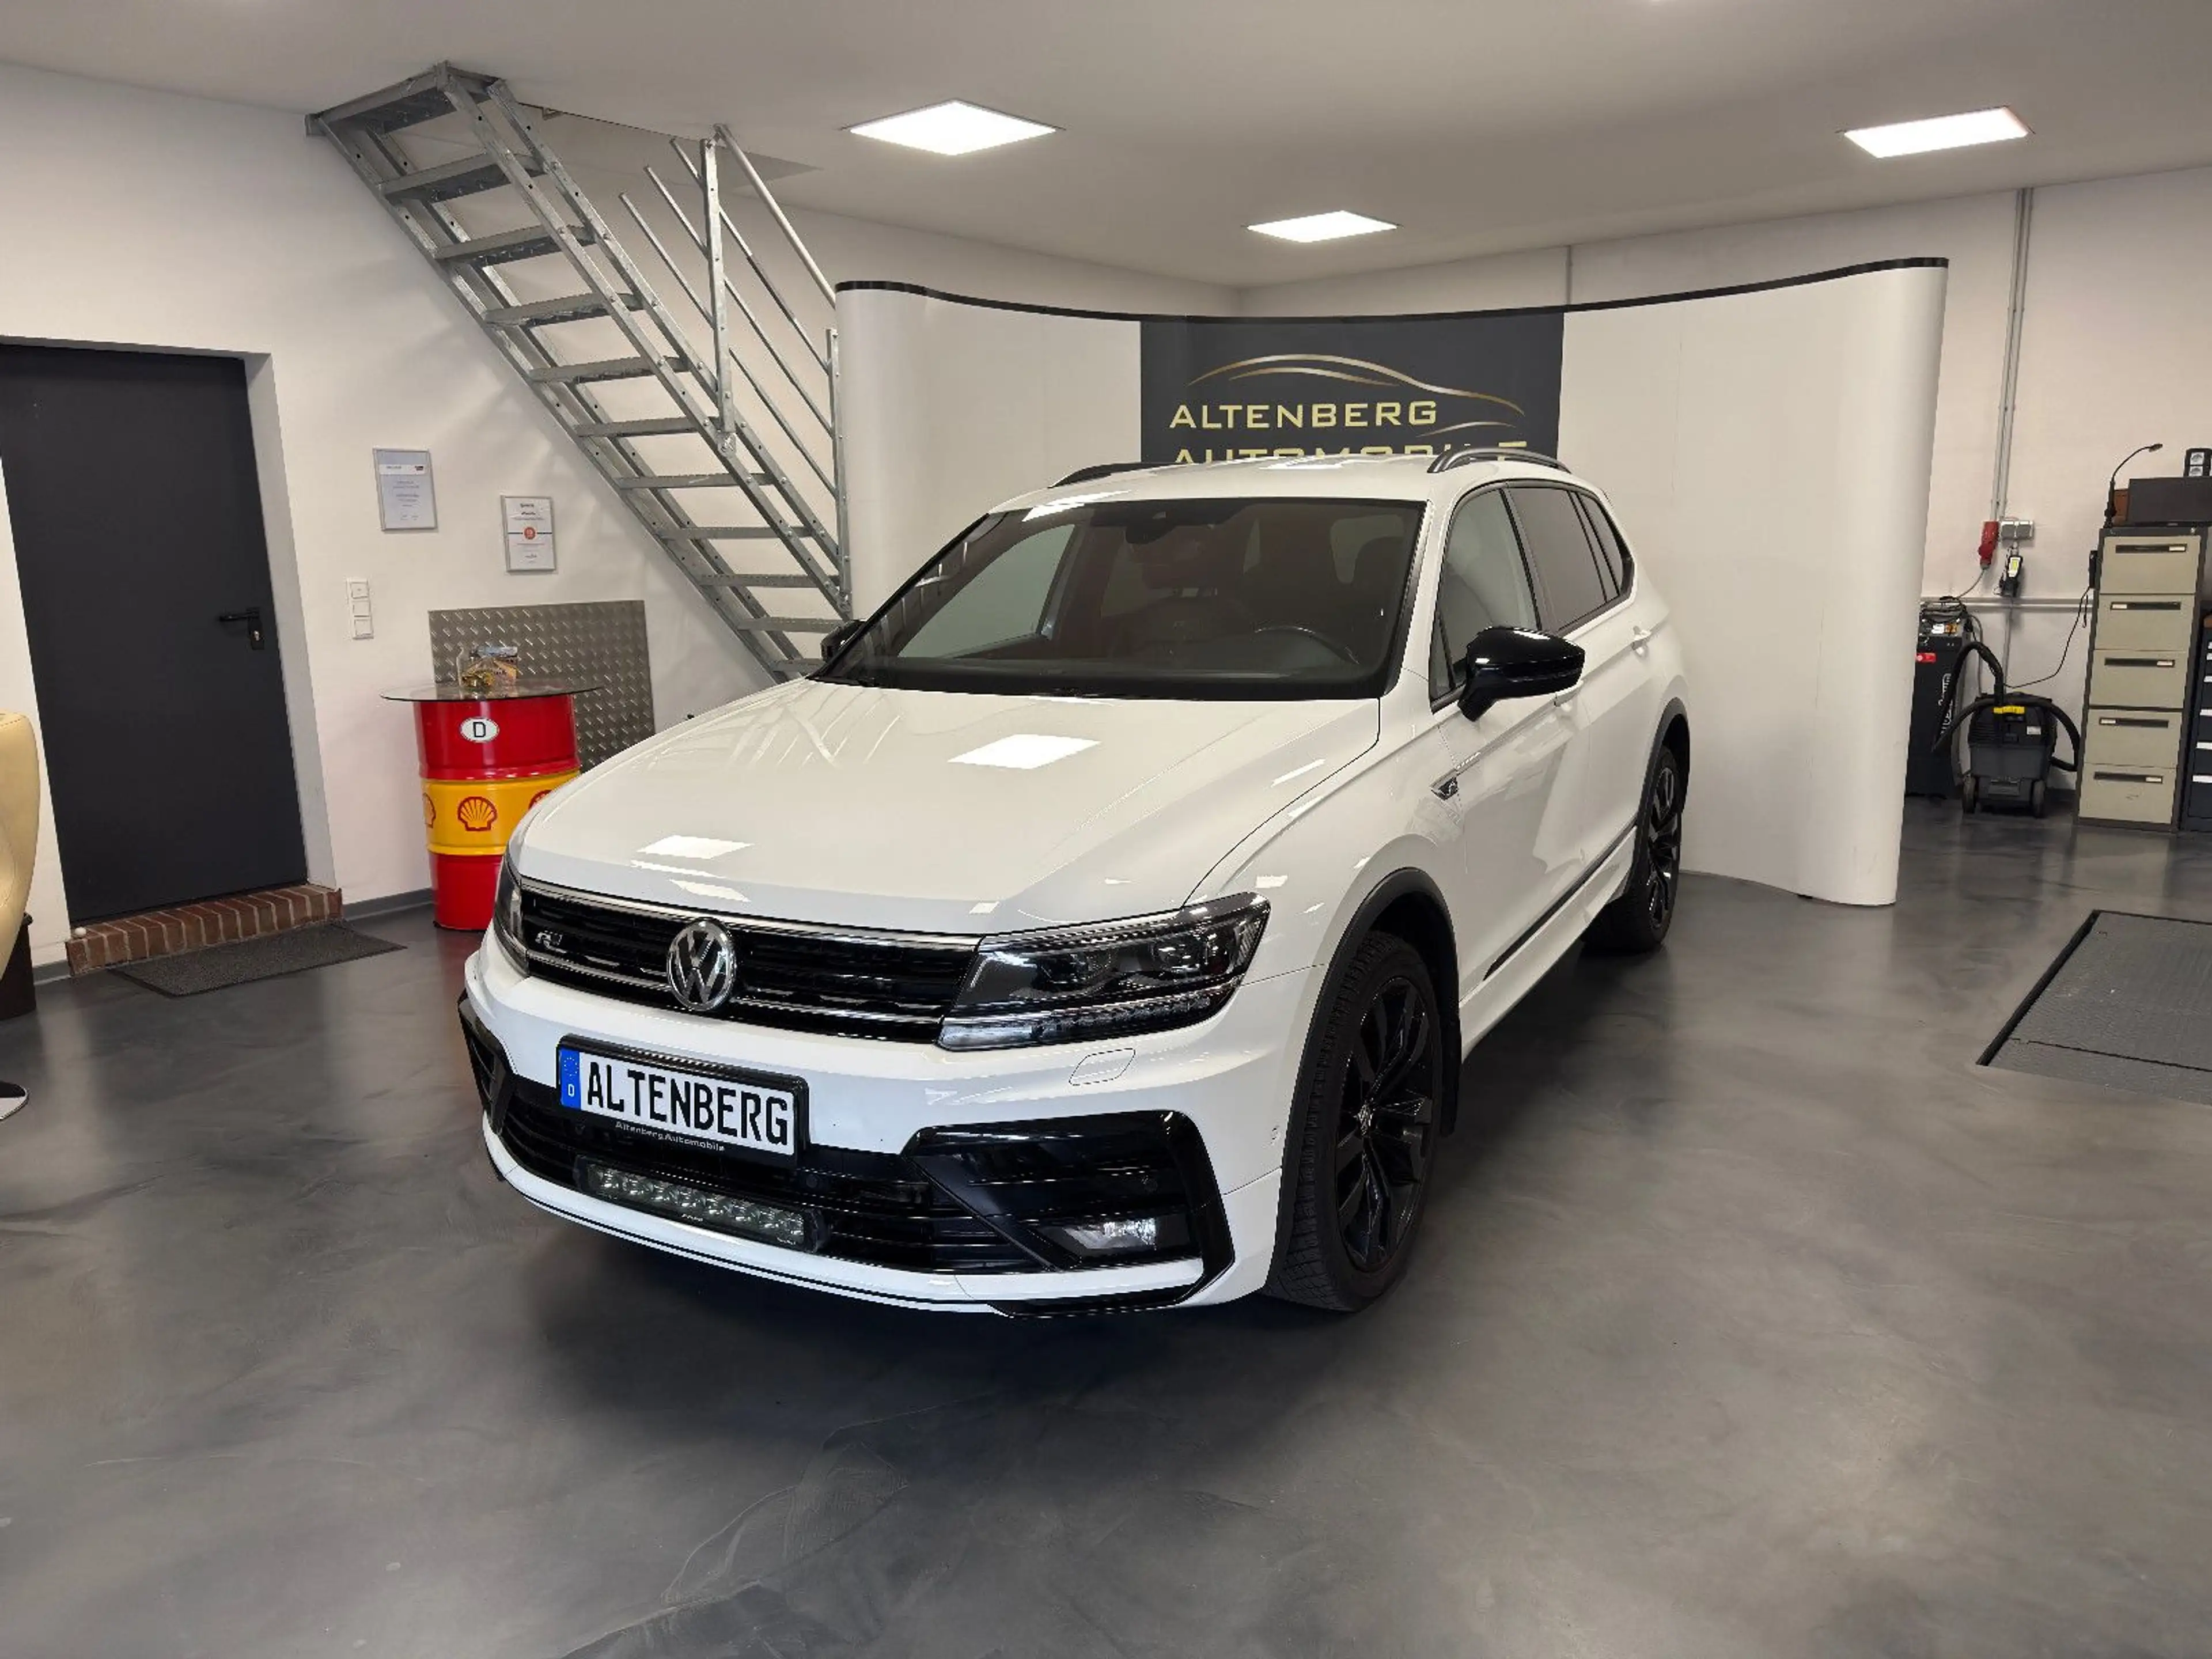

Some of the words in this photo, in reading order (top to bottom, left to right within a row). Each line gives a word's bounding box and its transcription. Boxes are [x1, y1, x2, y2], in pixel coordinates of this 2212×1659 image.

[1169, 400, 1437, 428] ALTENBERG
[472, 721, 487, 738] D
[567, 1084, 575, 1097] D
[587, 1061, 789, 1146] ALTENBERG
